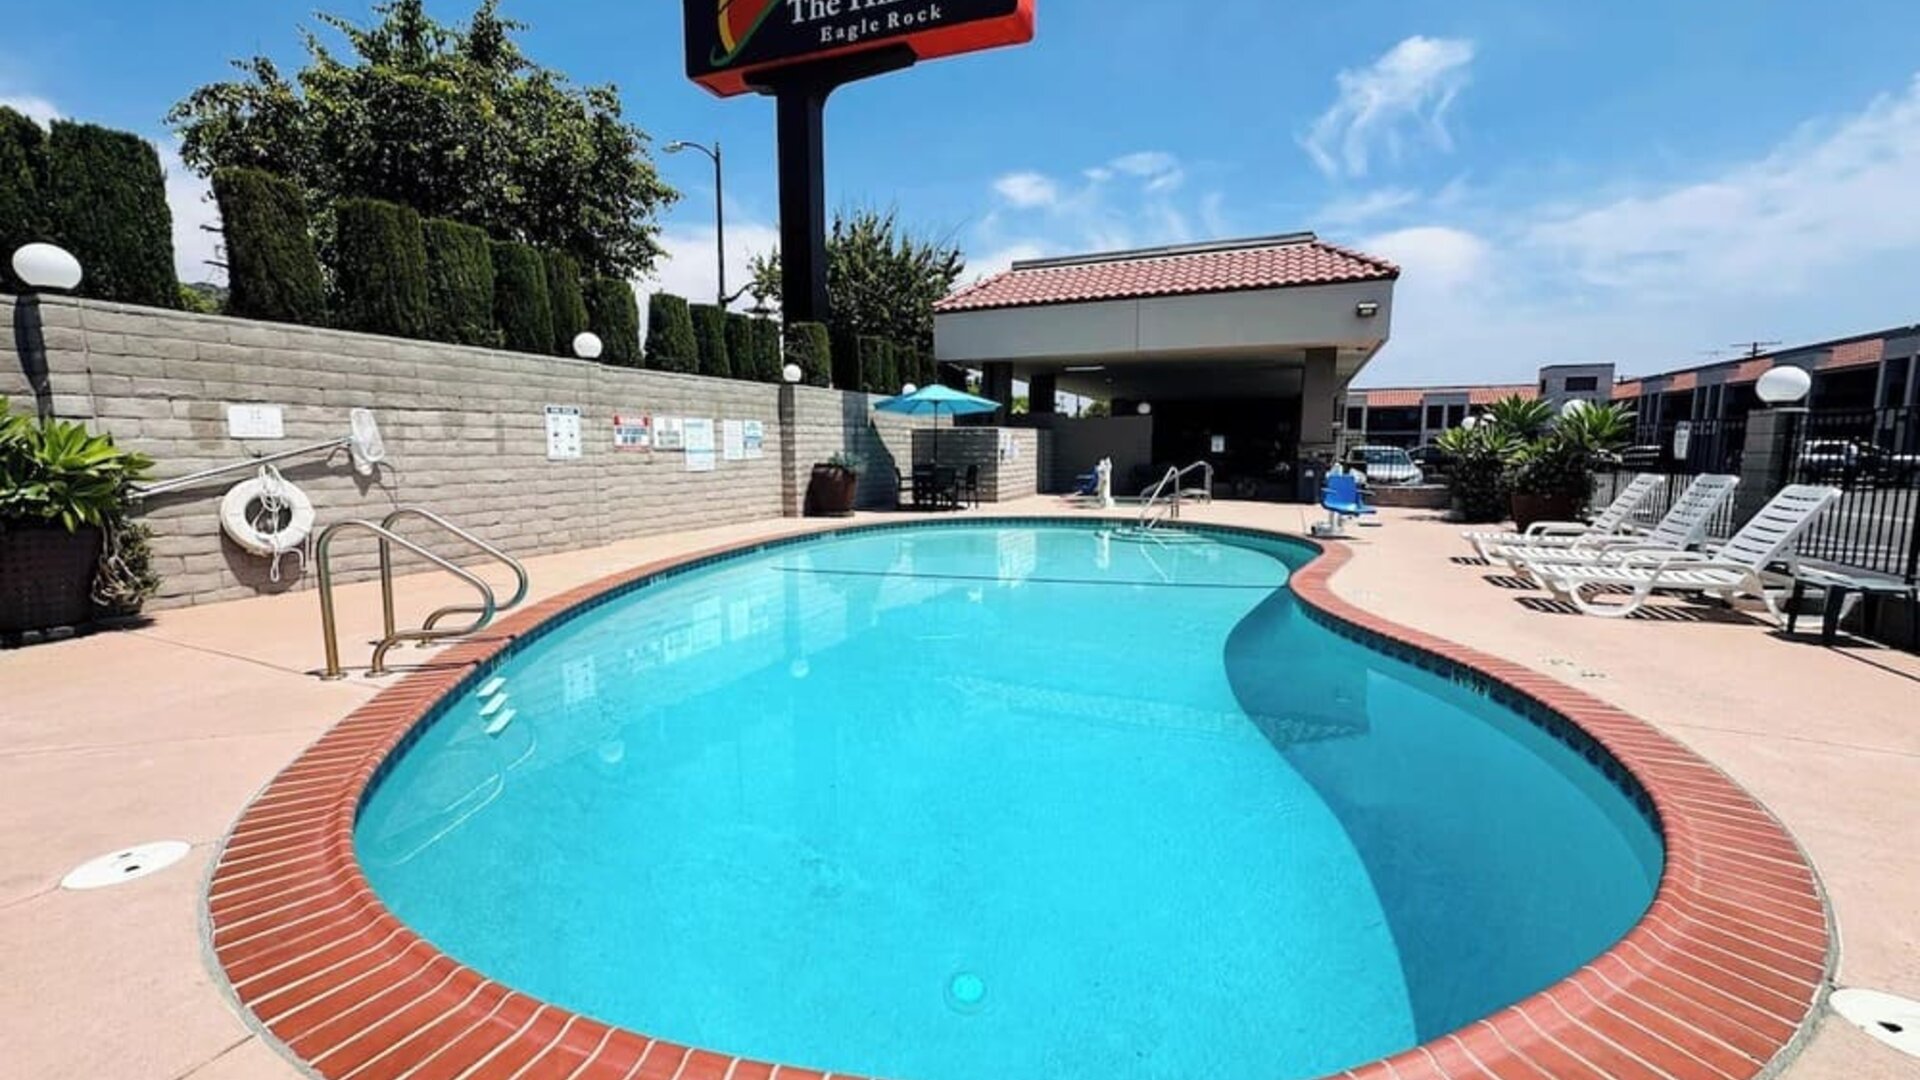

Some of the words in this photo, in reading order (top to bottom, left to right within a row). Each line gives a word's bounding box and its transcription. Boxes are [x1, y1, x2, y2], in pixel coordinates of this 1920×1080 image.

[787, 0, 841, 24] The
[820, 18, 880, 42] Eagle
[887, 3, 942, 29] Rock
